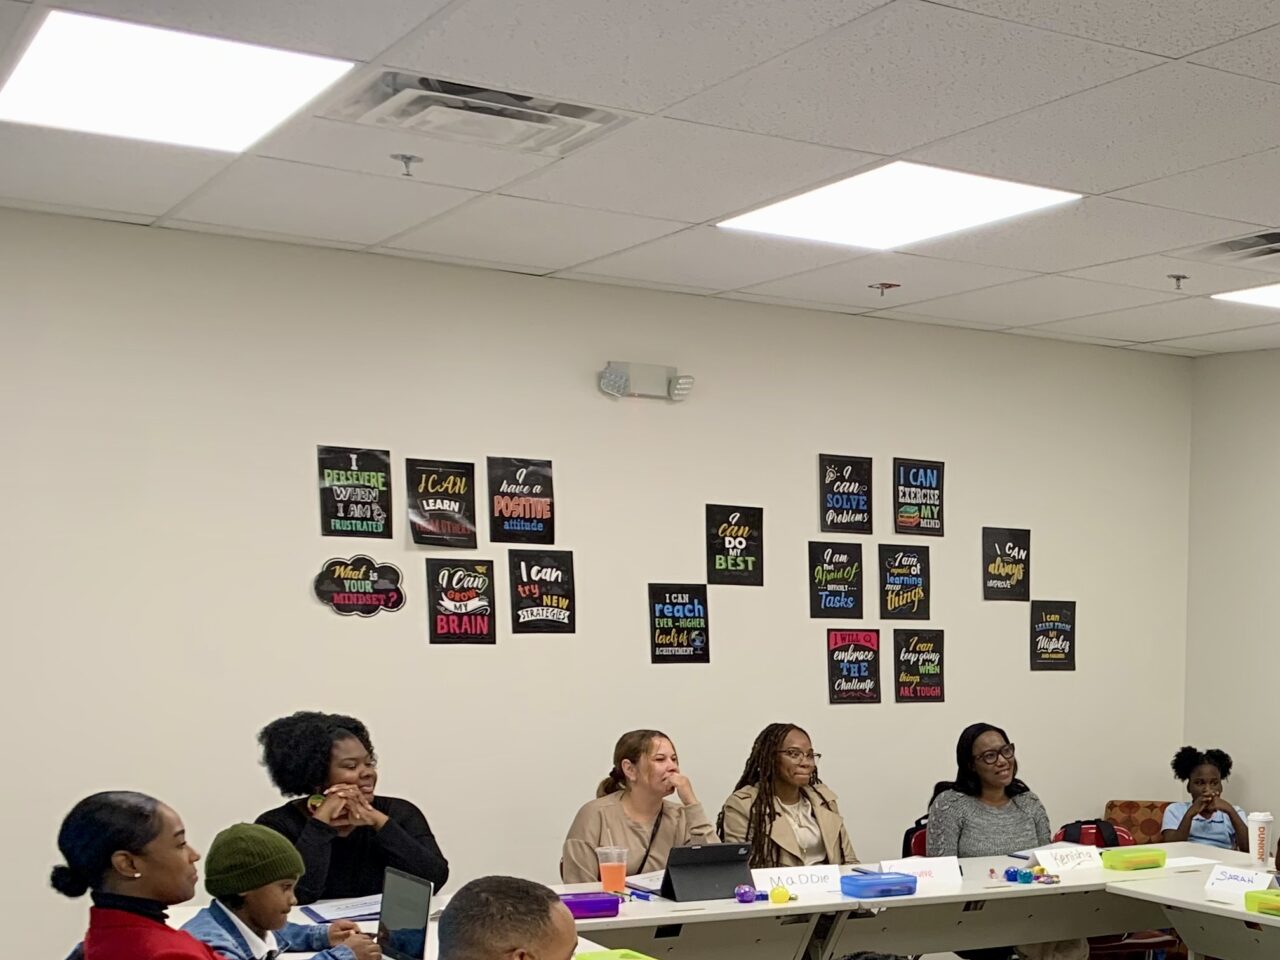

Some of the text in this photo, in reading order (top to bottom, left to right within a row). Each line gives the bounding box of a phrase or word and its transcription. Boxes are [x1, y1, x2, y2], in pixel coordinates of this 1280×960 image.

[350, 454, 358, 471] I
[324, 469, 387, 490] PERSEVERE
[516, 468, 527, 484] I
[843, 466, 852, 479] I
[900, 466, 937, 488] I CAN
[428, 474, 468, 495] CAN
[500, 480, 543, 494] have a
[834, 481, 860, 494] can
[332, 486, 379, 502] WHEN
[898, 486, 940, 505] EXERCISE
[422, 499, 459, 513] LEARN
[494, 496, 552, 519] POSITIVE
[826, 494, 868, 510] SOLVE
[336, 503, 371, 518] I AM
[826, 510, 869, 526] Problems
[920, 506, 940, 519] MY
[330, 519, 384, 533] FRUSTRATED
[504, 520, 544, 532] attitude
[729, 512, 740, 525] I
[920, 518, 941, 529] MIND
[718, 523, 752, 538] can
[725, 537, 747, 549] DO
[729, 548, 741, 556] MY
[824, 548, 848, 563] I am
[995, 542, 1027, 560] I CAN
[716, 554, 757, 571] BEST
[894, 552, 918, 567] I am
[331, 565, 378, 580] What is
[520, 561, 562, 583] I can
[814, 566, 843, 585] Afraid
[910, 563, 921, 575] of
[988, 556, 1025, 585] always
[344, 580, 373, 593] YOUR
[438, 570, 484, 589] I Can
[887, 572, 923, 587] learning
[447, 590, 478, 601] GROW
[518, 584, 539, 598] try
[542, 594, 569, 609] NEW
[666, 594, 689, 604] I CAN
[818, 592, 855, 609] Tasks
[886, 587, 925, 612] things
[454, 603, 468, 612] MY
[520, 608, 567, 621] STRATEGIES
[655, 599, 704, 618] reach
[437, 615, 489, 635] BRAIN
[1046, 614, 1060, 622] can
[655, 628, 688, 647] levels of
[834, 633, 861, 646] I WILL
[909, 636, 934, 651] I can
[1036, 634, 1071, 653] Mistakes
[656, 647, 694, 656] ACHIEVEMENT
[834, 644, 874, 663] embrace
[900, 648, 940, 665] keep going
[840, 662, 869, 677] THE
[919, 662, 940, 674] WHEN
[834, 679, 875, 693] Challenge
[899, 672, 920, 688] things
[900, 686, 941, 697] ARE TOUGH
